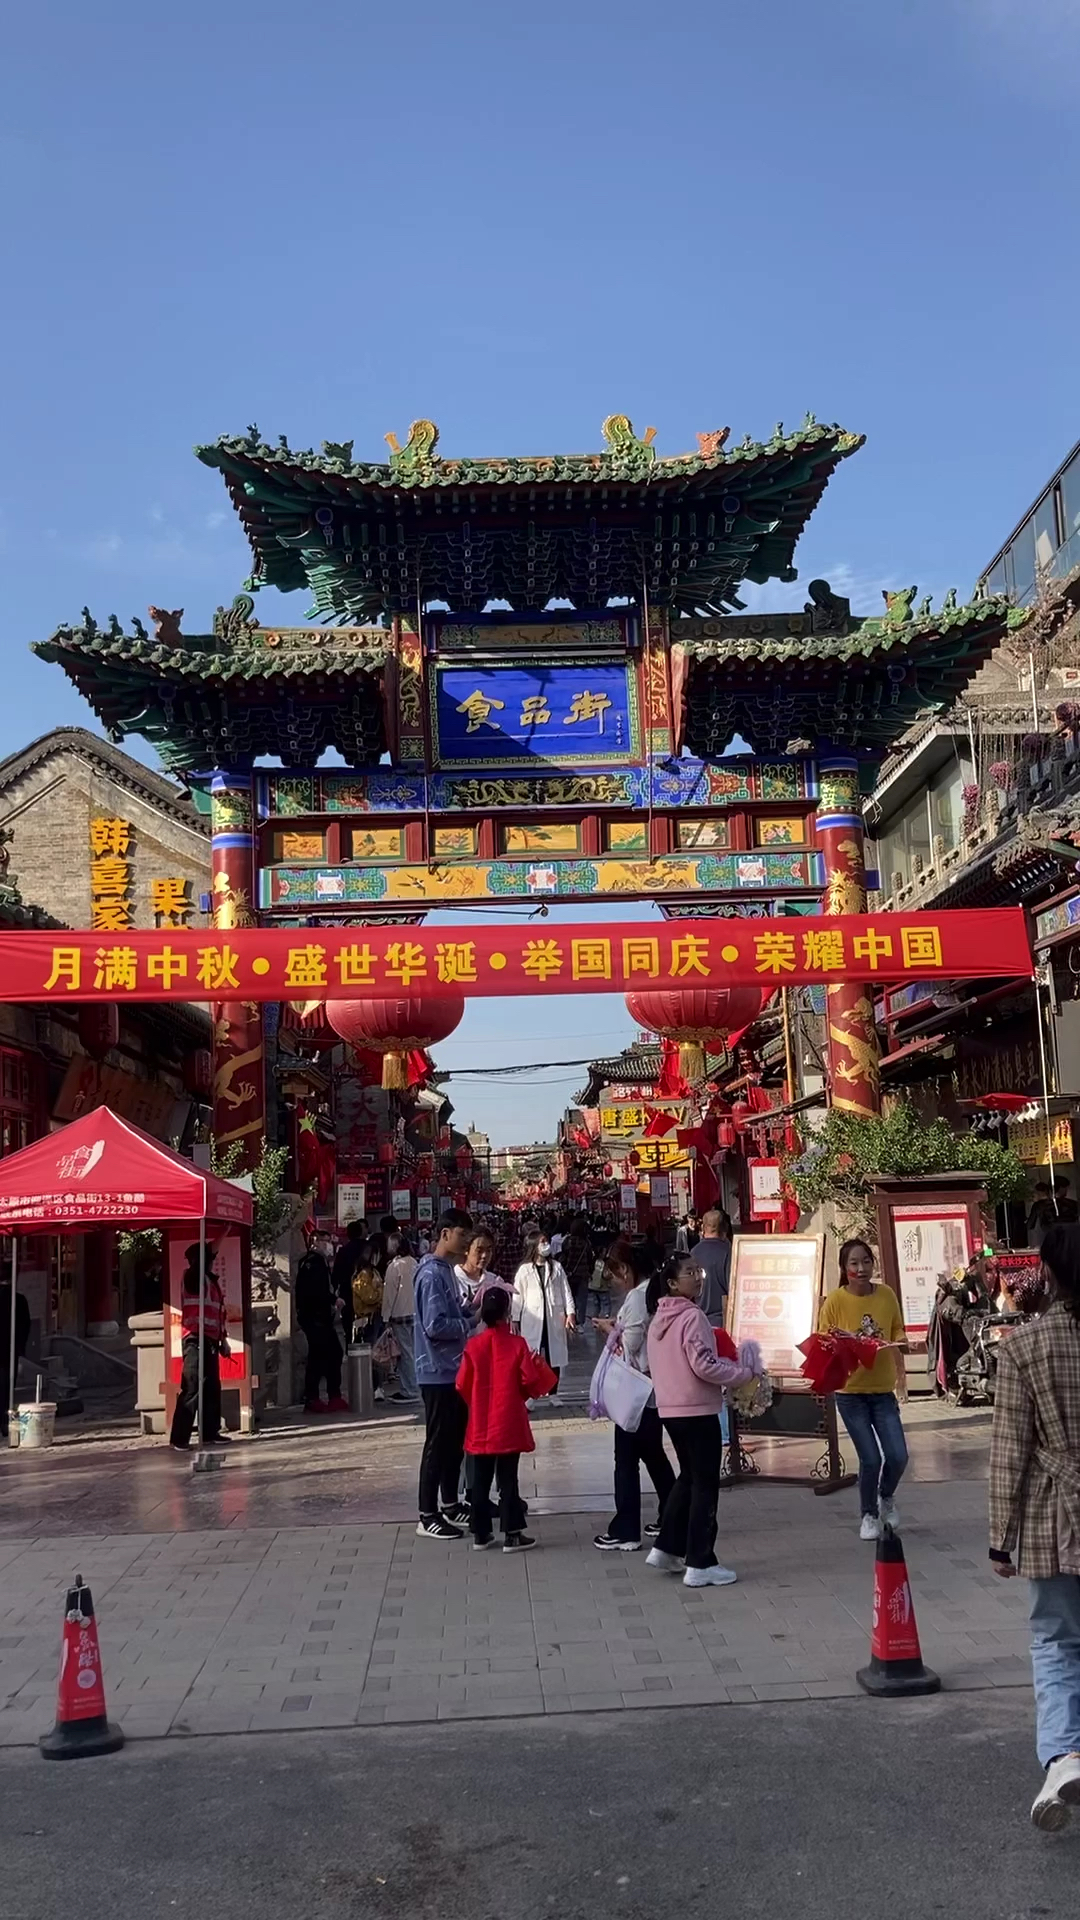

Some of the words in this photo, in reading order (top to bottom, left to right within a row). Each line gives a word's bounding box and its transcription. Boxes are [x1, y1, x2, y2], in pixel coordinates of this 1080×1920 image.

[455, 690, 612, 735] 食品街
[90, 817, 130, 931] 韩喜家
[151, 878, 189, 931] 果
